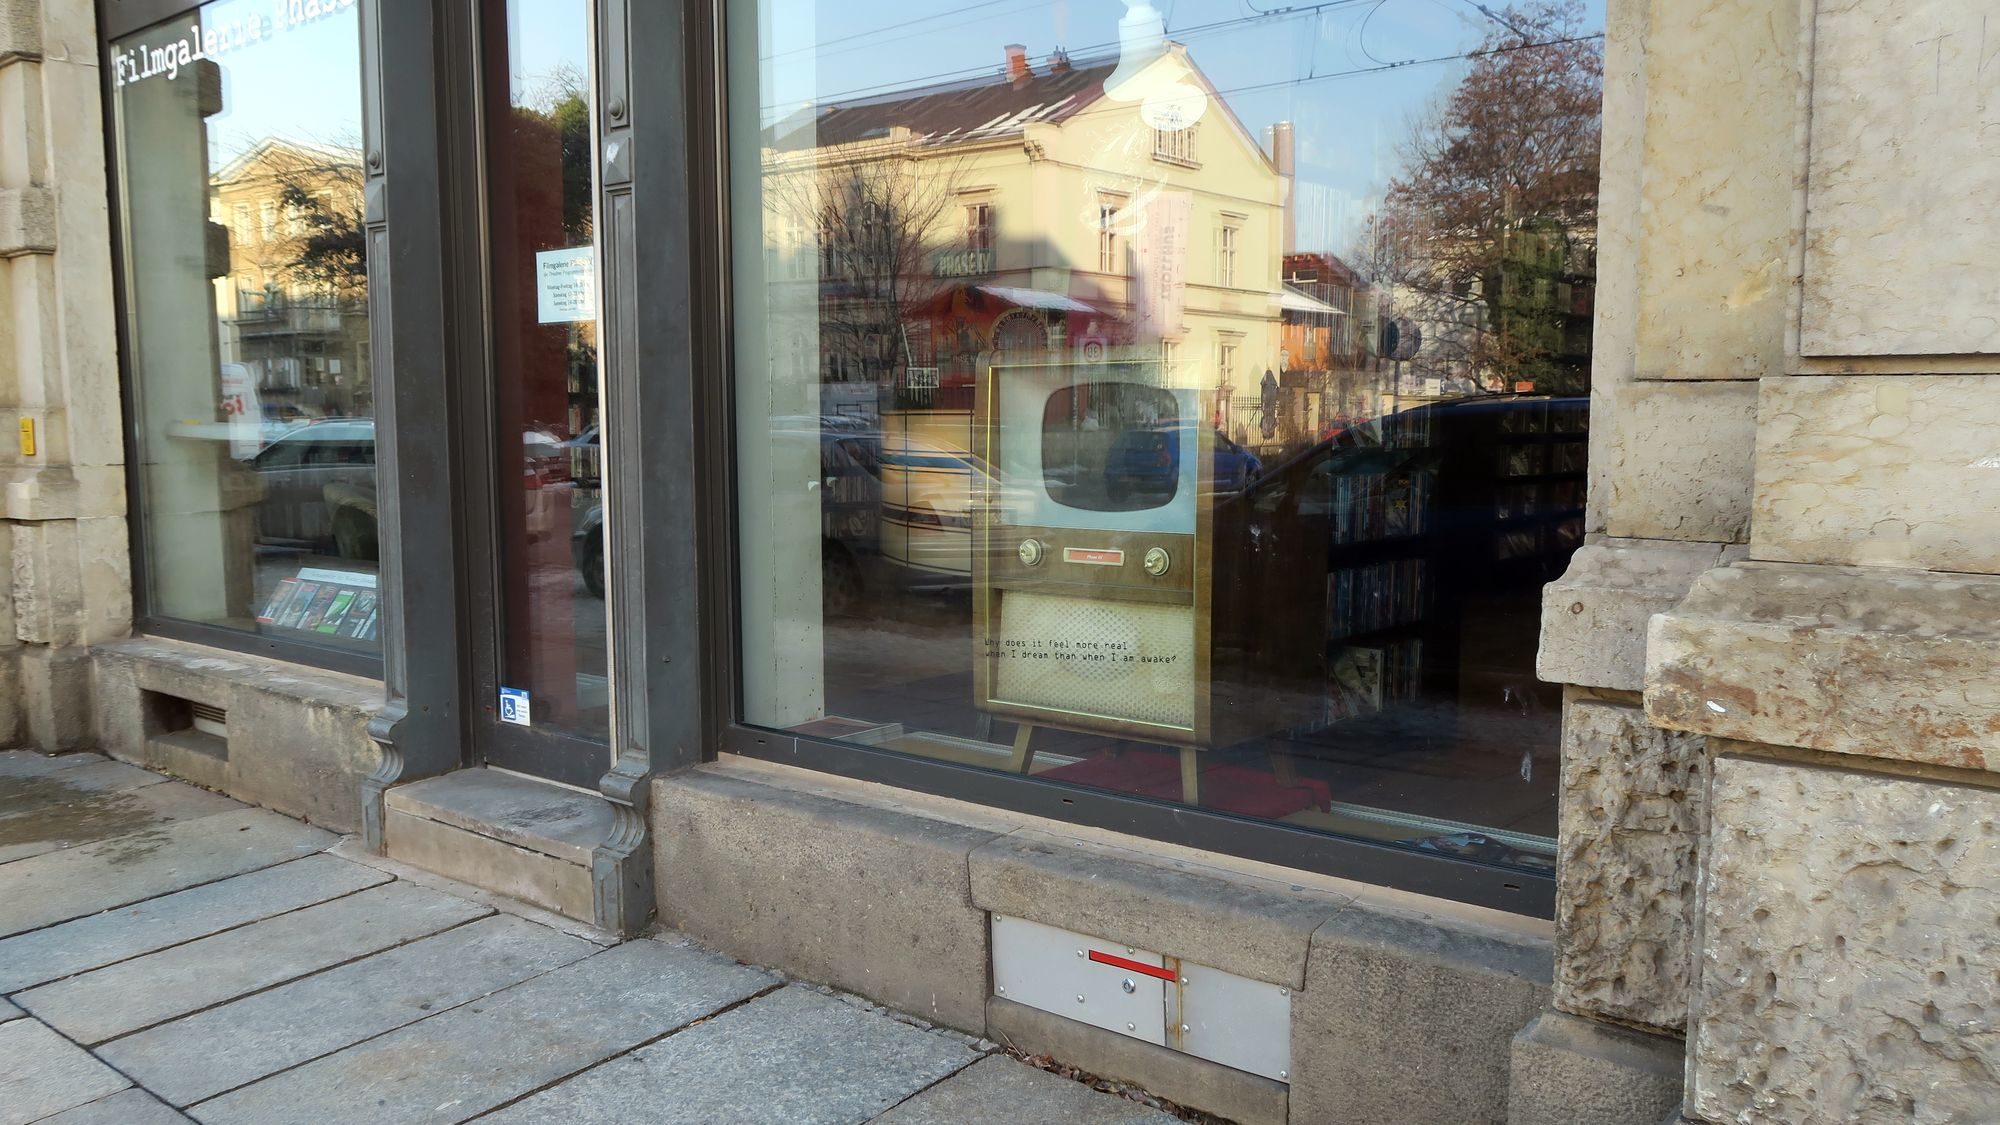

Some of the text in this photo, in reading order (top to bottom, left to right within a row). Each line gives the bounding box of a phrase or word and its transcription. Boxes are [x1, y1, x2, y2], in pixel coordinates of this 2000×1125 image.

[116, 14, 262, 87] Filmgalerie
[984, 638, 1000, 649] Why
[1032, 640, 1042, 648] it
[1049, 640, 1070, 649] feel
[1076, 642, 1099, 650] more
[1104, 642, 1128, 650] real
[985, 649, 1006, 658] when
[1011, 649, 1017, 659] I
[1022, 650, 1049, 659] dream
[1055, 651, 1077, 660] than
[1082, 652, 1105, 661] when
[1111, 652, 1116, 662] I
[1141, 655, 1177, 664] awake?
